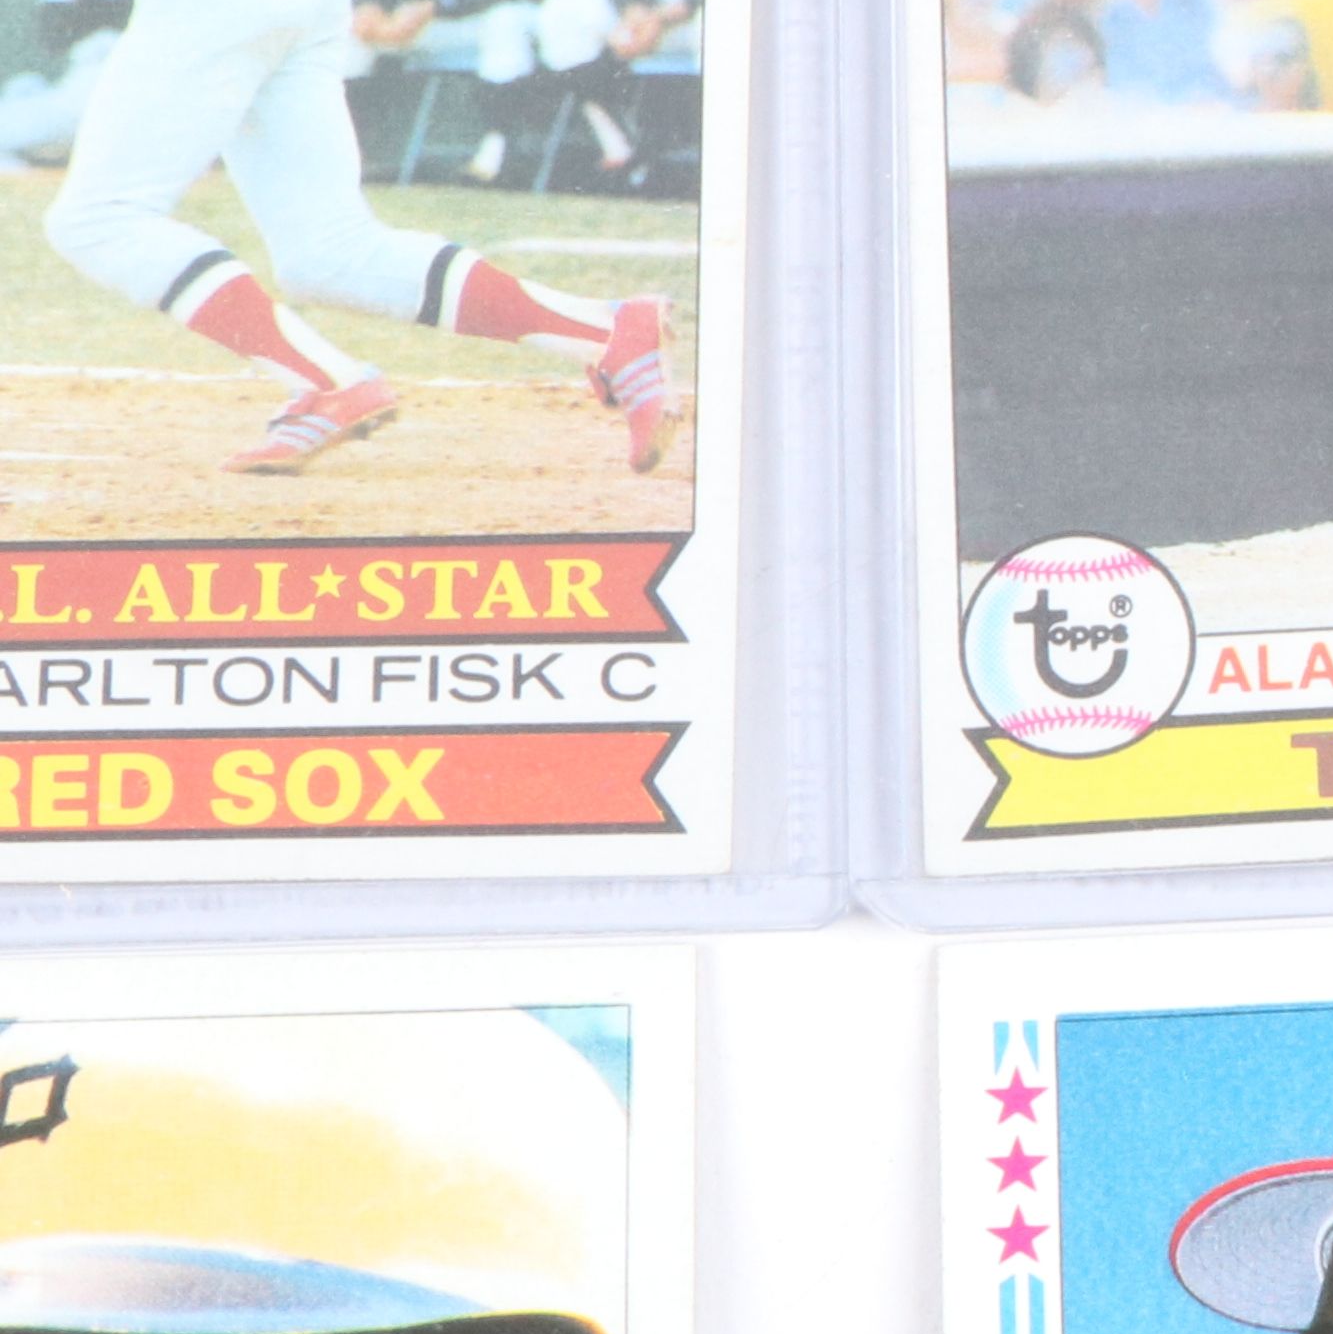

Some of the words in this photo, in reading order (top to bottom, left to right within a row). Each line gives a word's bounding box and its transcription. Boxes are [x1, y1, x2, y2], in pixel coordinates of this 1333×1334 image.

[0, 564, 92, 623] L.
[113, 560, 318, 623] ALL
[357, 557, 609, 622] STAR
[371, 652, 565, 704] FISK
[600, 651, 658, 703] C
[210, 747, 445, 825] SOX
